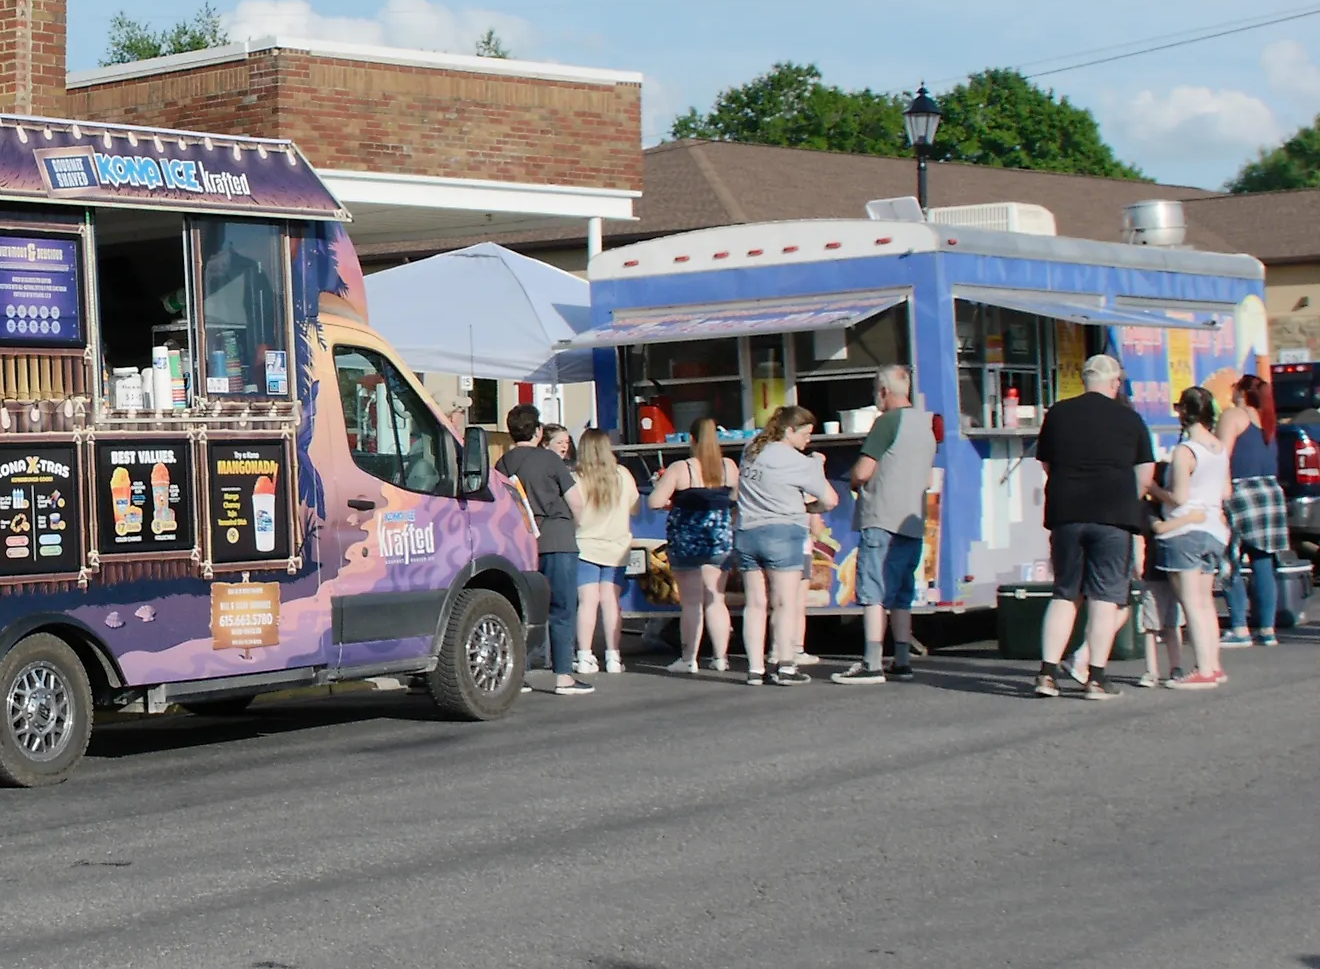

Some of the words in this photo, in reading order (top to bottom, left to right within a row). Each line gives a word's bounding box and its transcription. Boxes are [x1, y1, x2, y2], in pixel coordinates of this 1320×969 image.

[56, 172, 89, 187] SHAVED
[94, 153, 163, 189] KONA
[160, 158, 203, 193] ICE
[110, 451, 136, 464] BEST
[138, 450, 177, 463] VALUES.
[217, 460, 277, 474] MANGONADA
[739, 464, 763, 482] 021
